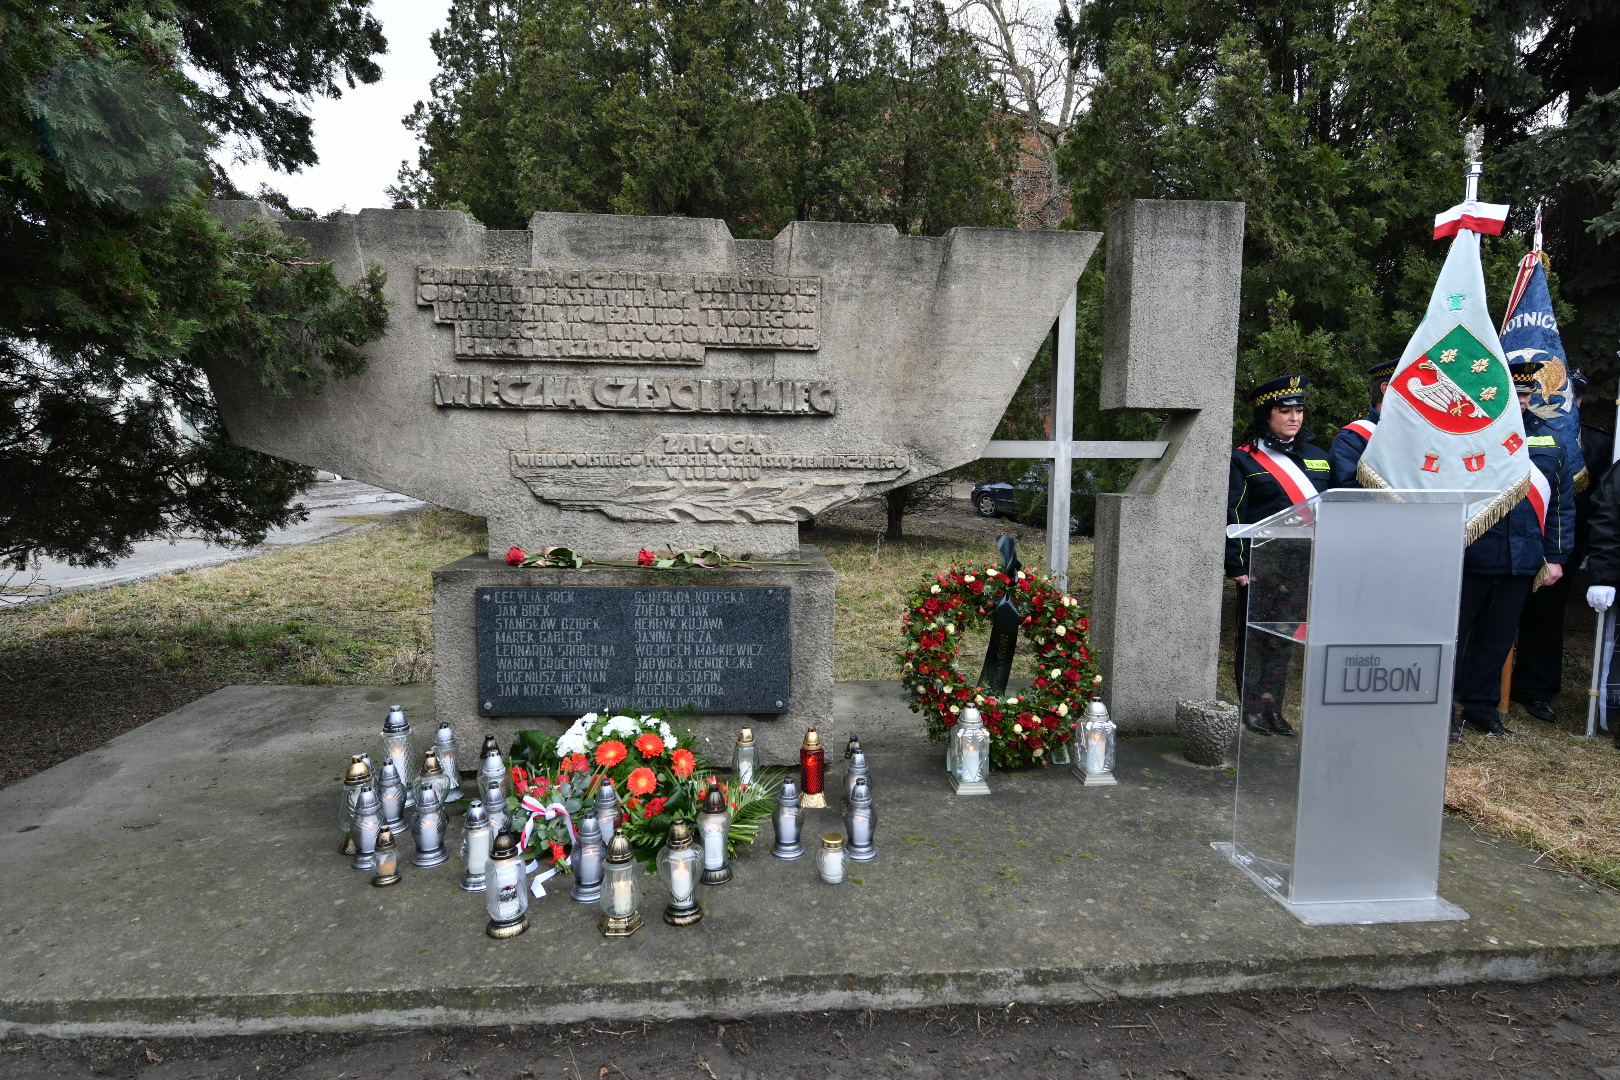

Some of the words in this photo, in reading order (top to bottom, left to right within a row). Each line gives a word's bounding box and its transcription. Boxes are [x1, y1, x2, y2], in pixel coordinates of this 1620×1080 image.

[721, 310, 815, 330] KOLEGOM
[433, 373, 586, 409] WIECZNA
[514, 452, 643, 468] WIELKOPOLSKIEGO
[495, 605, 517, 617] JAN
[634, 604, 666, 617] ZOFIA
[634, 617, 677, 630] HENRYK
[681, 617, 724, 630] KUJAWA
[495, 631, 535, 644] MAREK
[496, 644, 554, 657] LEONARDA
[496, 657, 534, 670] WANDA
[634, 657, 684, 670] JADWIGA
[1345, 654, 1380, 667] miasto
[496, 671, 557, 684] EUGENIUSZ
[561, 671, 607, 683] HETMAN
[634, 670, 673, 683] ROMAN
[1343, 663, 1421, 693] LUBOŃ
[497, 684, 519, 697] JAN
[634, 683, 682, 696] TADEUSZ
[686, 683, 726, 696] SIKORA
